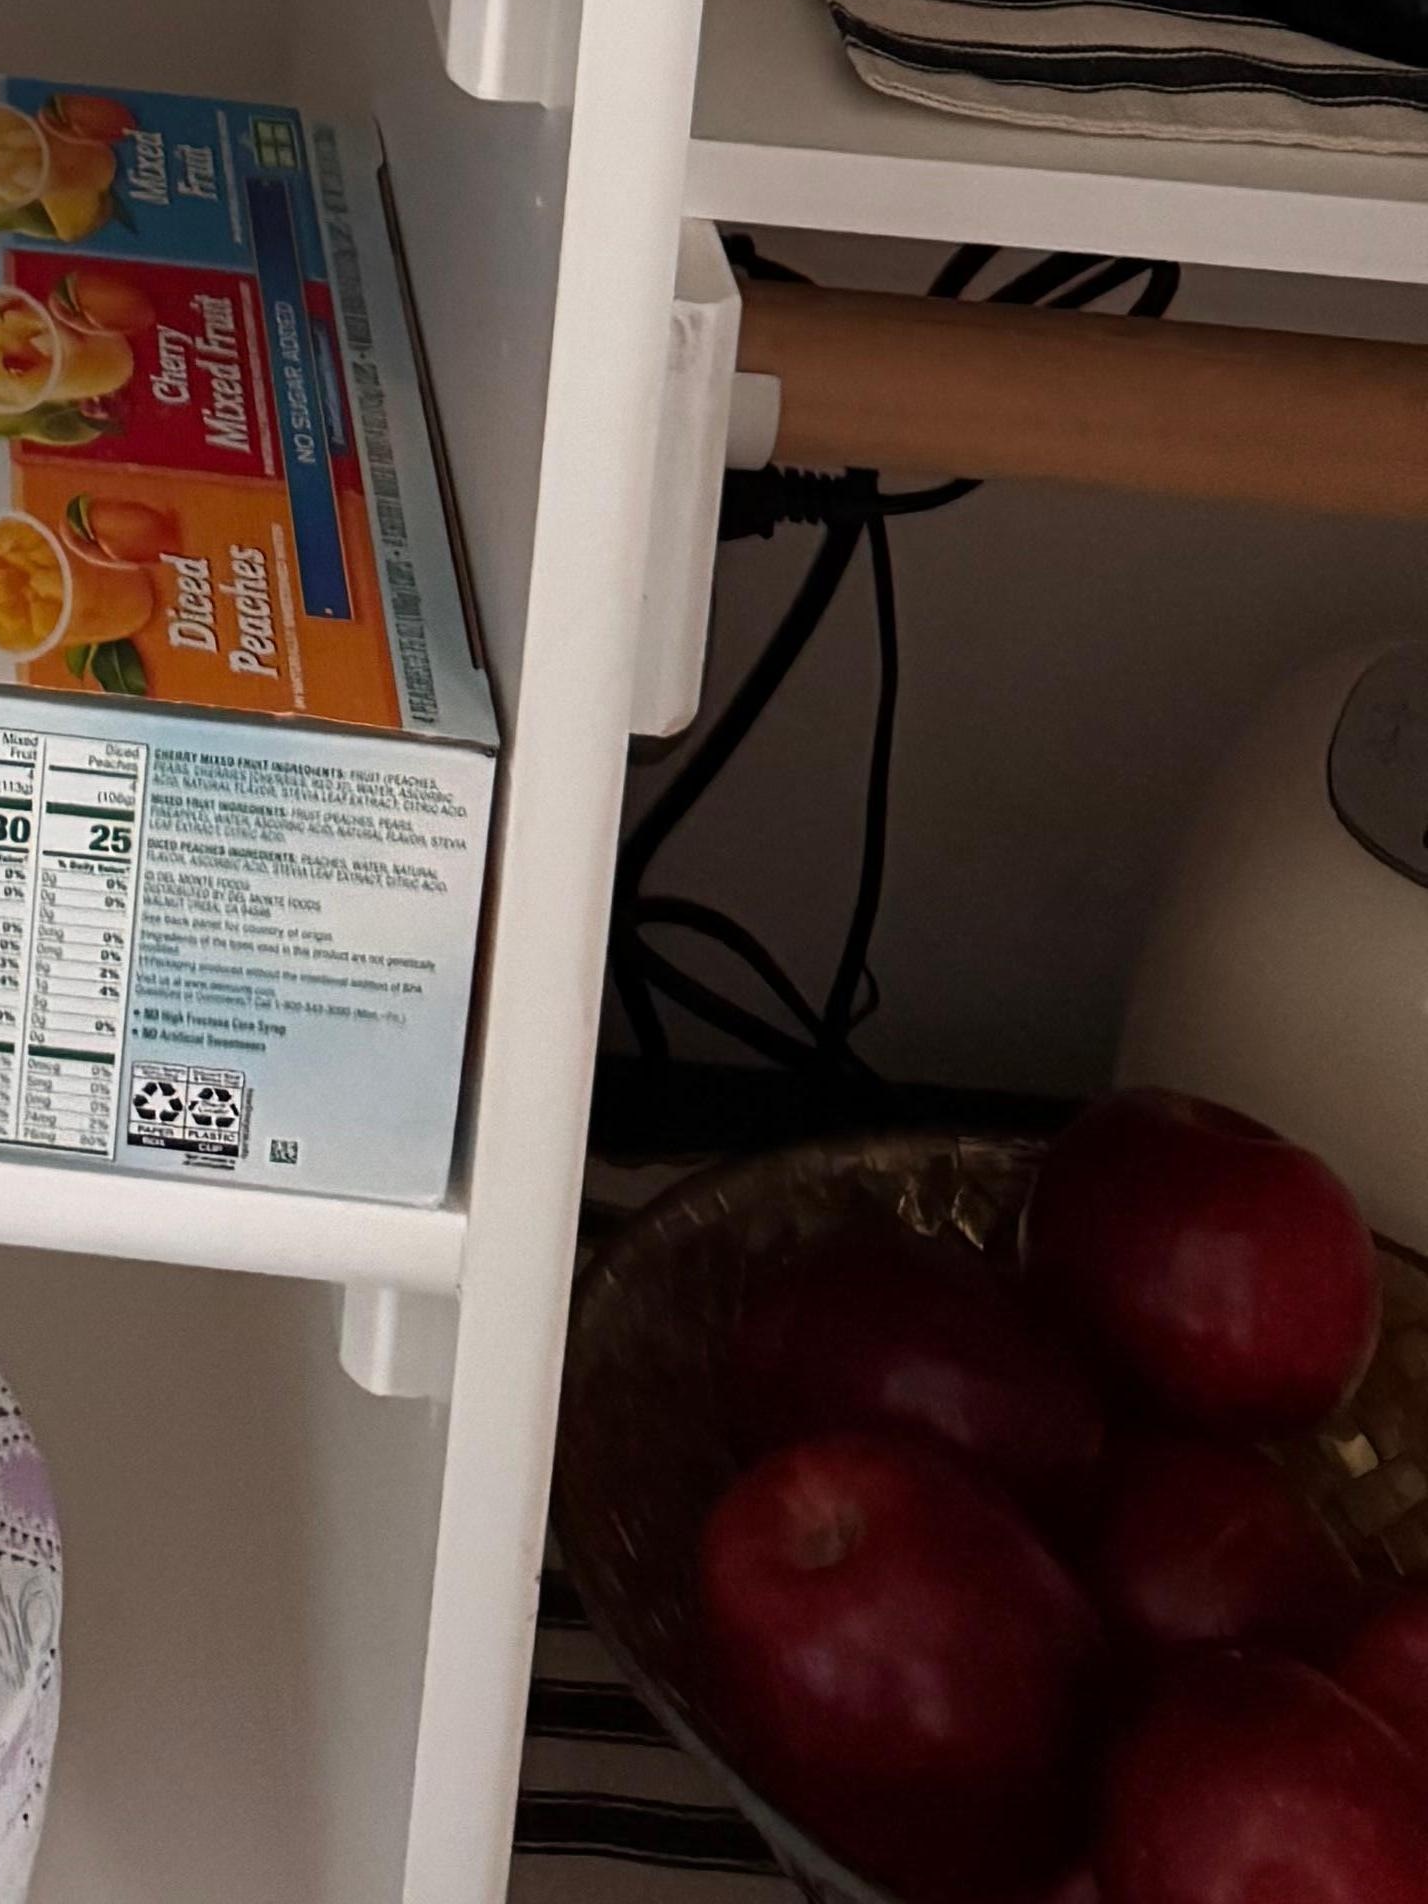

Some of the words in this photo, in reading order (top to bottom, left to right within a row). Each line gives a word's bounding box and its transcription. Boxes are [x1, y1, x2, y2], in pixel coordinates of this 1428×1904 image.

[122, 128, 169, 205] Mixed
[178, 145, 217, 201] Fruit
[190, 294, 242, 360] Fruit
[274, 300, 301, 362] ADDED
[150, 325, 192, 405] Cherry
[196, 352, 252, 454] Mixed
[284, 364, 314, 430] SUGAR
[295, 433, 317, 464] NO
[159, 552, 218, 653] Diced
[220, 545, 279, 680] Peaches
[2, 732, 38, 747] Mixed
[10, 746, 38, 759] Fruit
[105, 744, 140, 759] Diced
[88, 824, 132, 854] 25
[188, 1130, 236, 1143] PLASTIC
